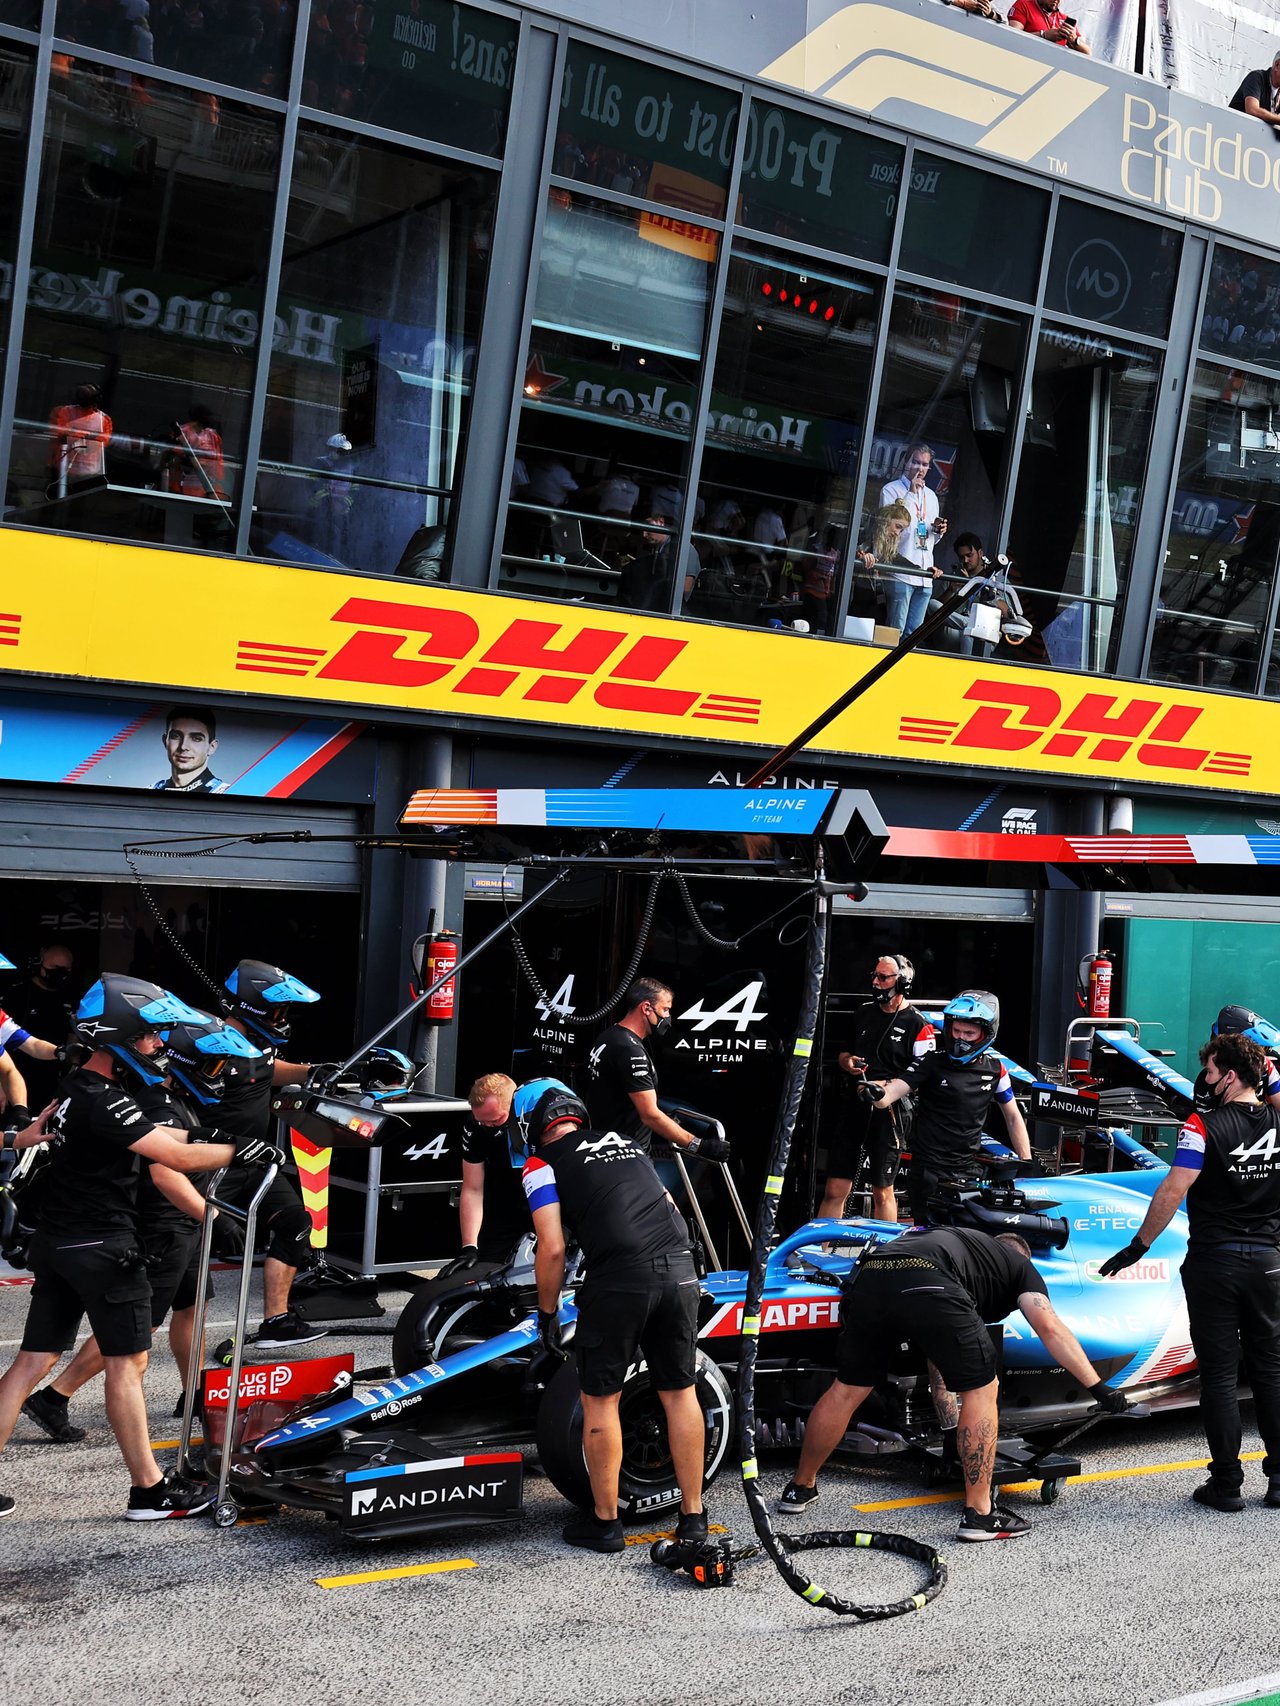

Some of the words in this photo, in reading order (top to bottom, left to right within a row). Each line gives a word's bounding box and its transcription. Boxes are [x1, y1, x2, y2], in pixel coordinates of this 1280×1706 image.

[1120, 145, 1222, 222] Club
[319, 598, 700, 715] DHL
[954, 681, 1208, 769] DHL
[744, 799, 807, 810] ALPINE
[533, 1028, 575, 1044] ALPINE
[675, 1039, 767, 1050] ALPINE
[715, 1054, 743, 1062] TEAM
[1038, 1091, 1096, 1117] MANDIANT
[371, 1408, 388, 1422] Bell
[387, 1400, 402, 1416] &
[401, 1394, 423, 1409] Ross
[351, 1481, 506, 1517] MANDIANT
